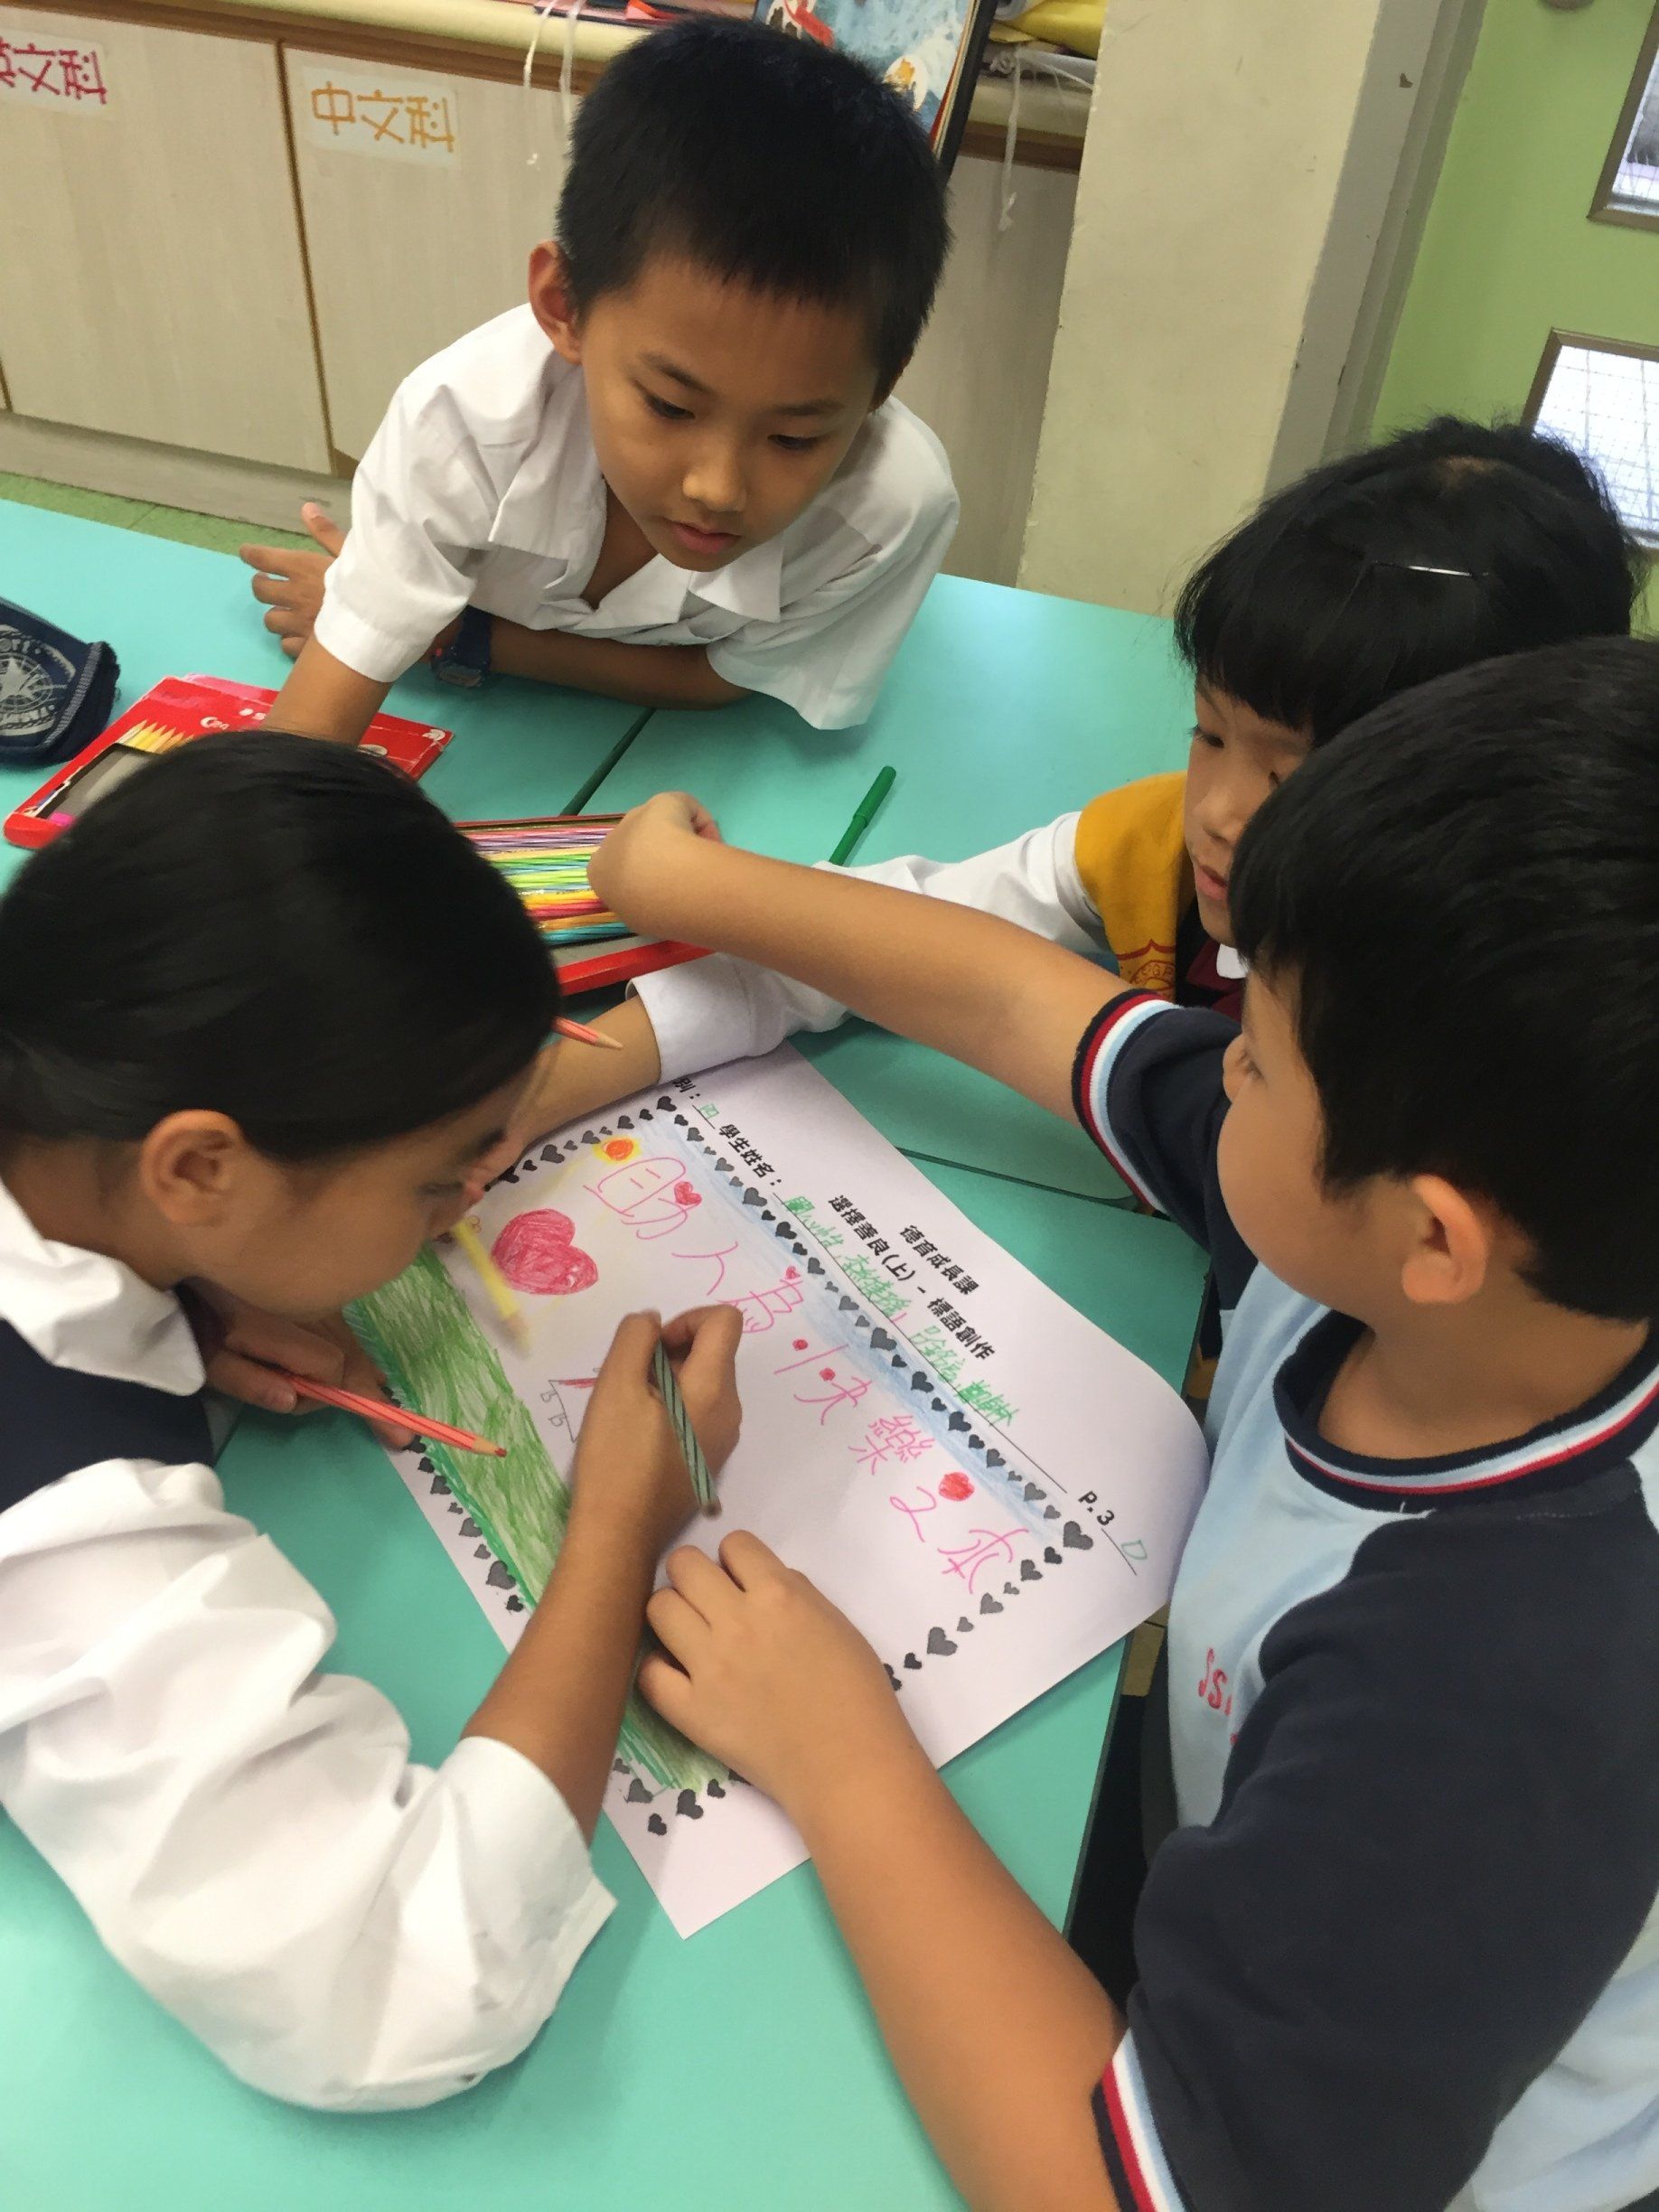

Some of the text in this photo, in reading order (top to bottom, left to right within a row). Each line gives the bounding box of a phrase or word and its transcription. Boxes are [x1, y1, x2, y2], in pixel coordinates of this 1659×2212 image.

[311, 81, 455, 153] 中文科
[899, 1223, 980, 1296] 德育成長課
[925, 1297, 996, 1362] 標語創作
